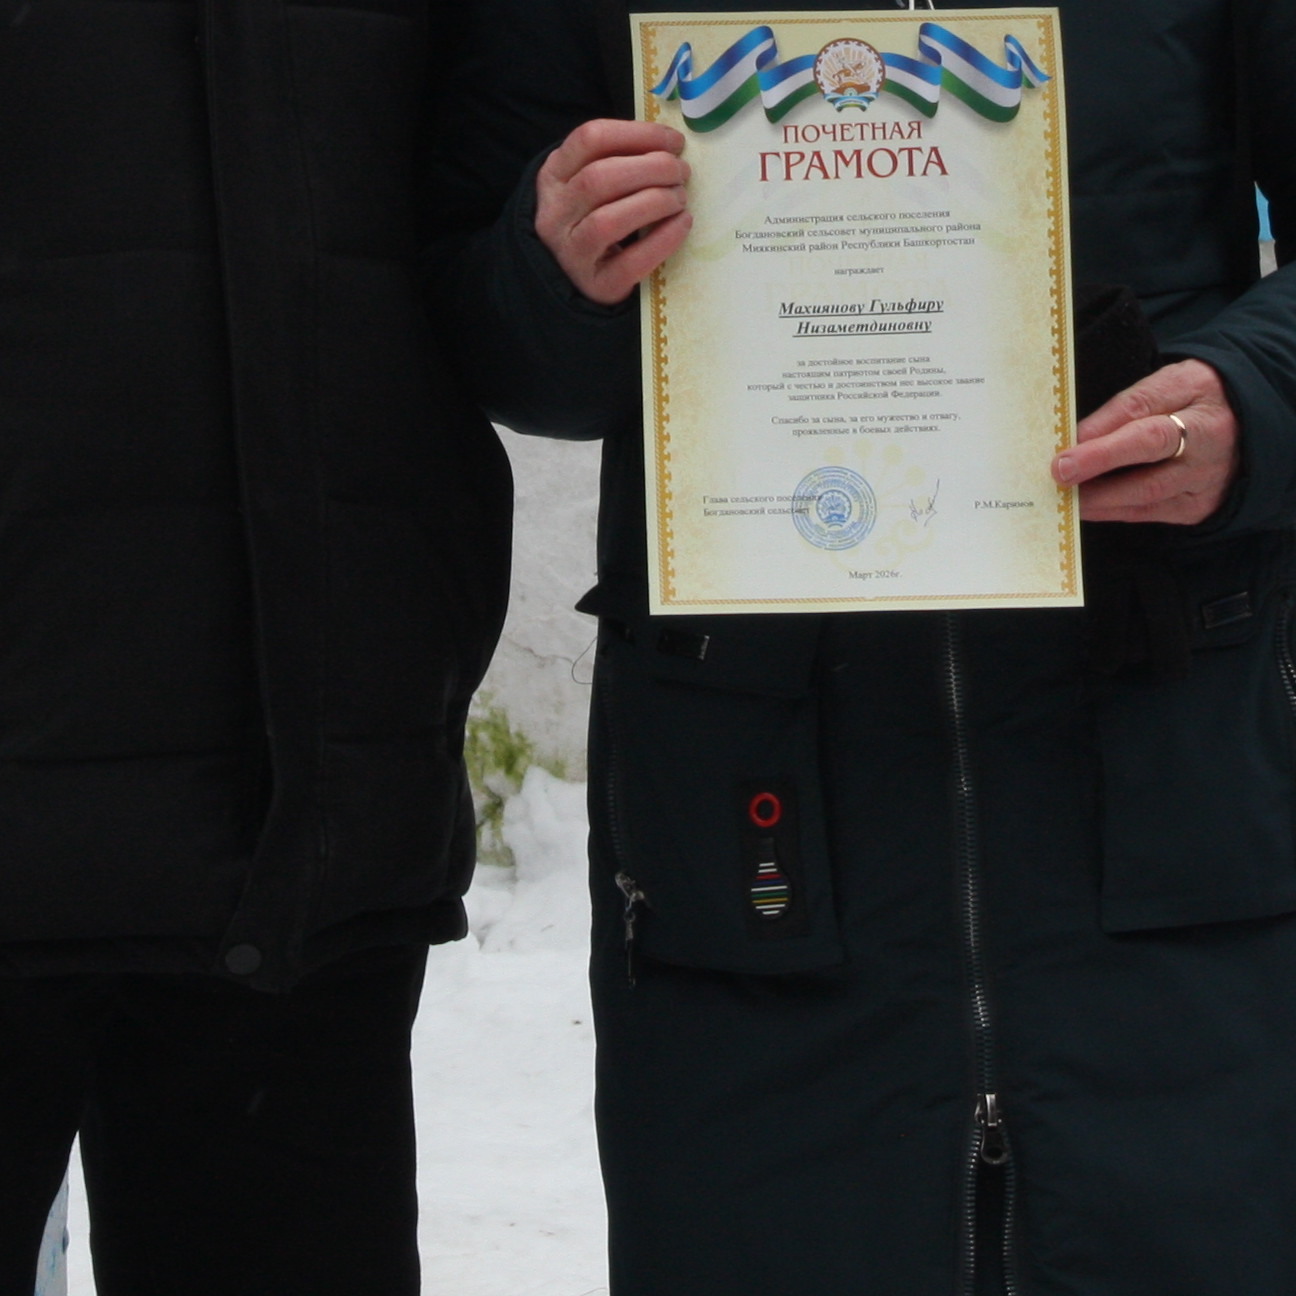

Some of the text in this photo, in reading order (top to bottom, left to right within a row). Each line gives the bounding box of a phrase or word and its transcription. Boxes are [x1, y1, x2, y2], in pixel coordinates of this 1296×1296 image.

[782, 120, 924, 145] ПОЧЕТНАЯ
[758, 145, 950, 182] ГРАМОТА
[764, 210, 951, 226] Администрация сельского поселения
[735, 222, 981, 240] Богдановский сельсовет муниципального района
[742, 237, 975, 253] Миякинский район Республики Башкортостан
[834, 265, 885, 276] награждает
[778, 298, 945, 316] Махиянову Гульфиру
[797, 319, 932, 335] Низаметдиновну
[808, 357, 854, 367] достойное
[856, 356, 906, 365] воспитание
[908, 355, 931, 364] сына
[833, 368, 880, 379] патриотом
[882, 366, 907, 375] своей
[747, 382, 785, 392] который
[795, 382, 826, 390] честью
[835, 379, 897, 389] достоинством
[899, 379, 915, 387] нес
[917, 378, 953, 386] высокое
[955, 376, 985, 384] звание
[837, 390, 888, 401] Российской
[771, 415, 809, 425] Спасибо
[811, 416, 821, 424] за
[849, 415, 858, 423] за
[860, 415, 875, 423] его
[877, 413, 920, 424] мужество
[929, 412, 961, 422] отвагу,
[792, 427, 850, 437] проявленные
[859, 424, 891, 435] боевых
[703, 494, 729, 504] Глава
[731, 494, 774, 504] сельского
[704, 507, 766, 517] Богдановский
[849, 570, 872, 581] Март
